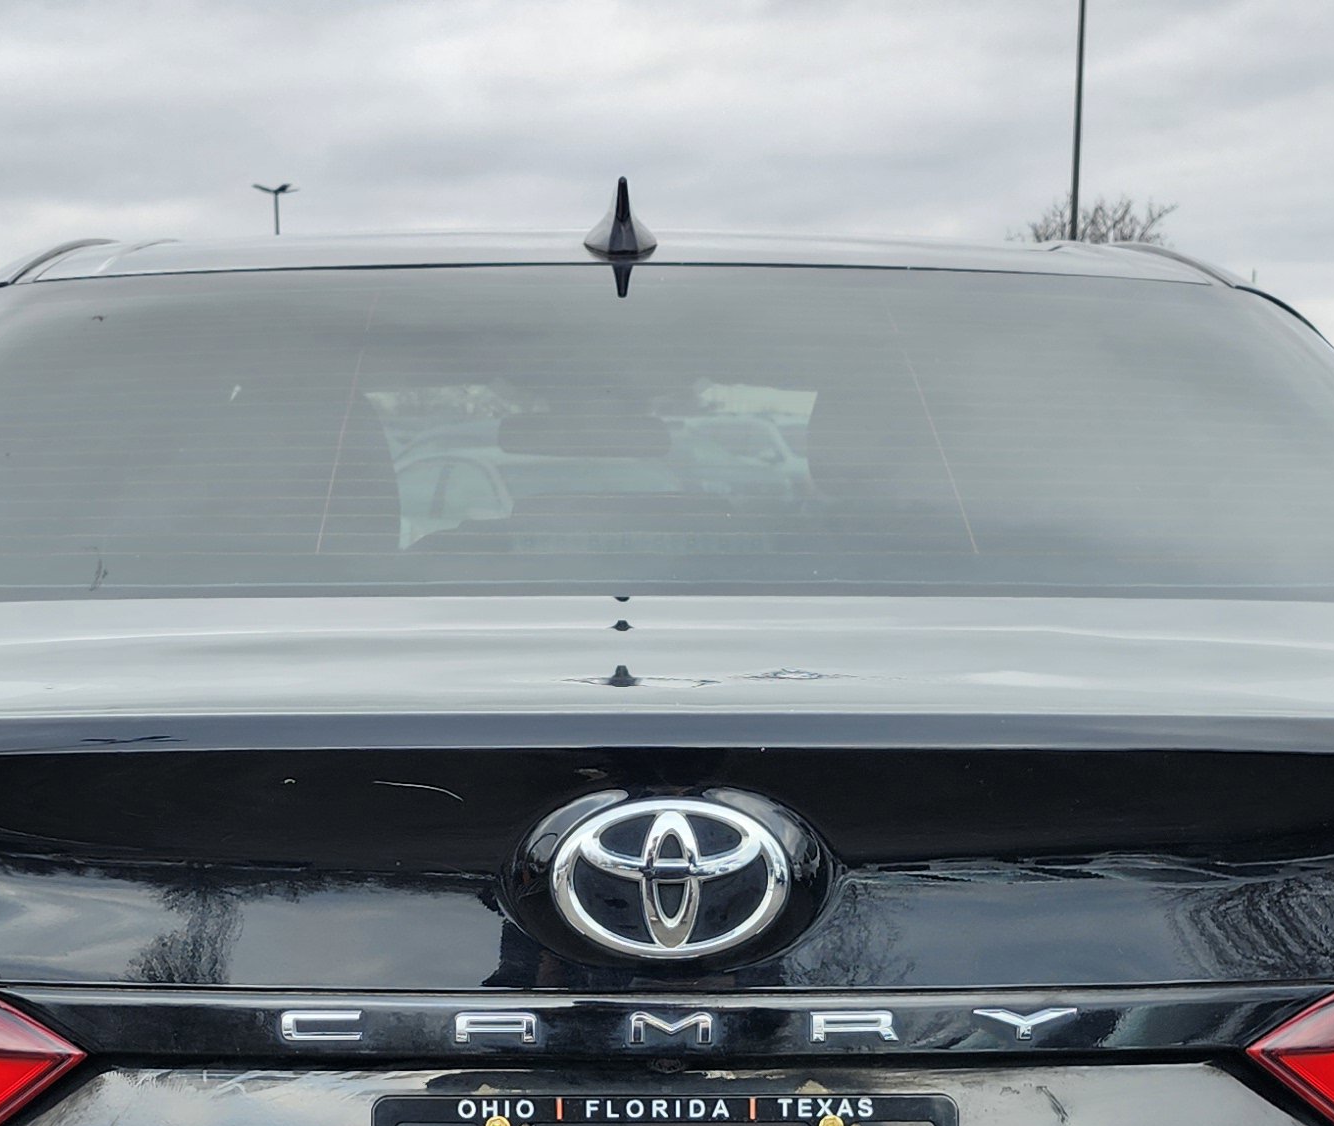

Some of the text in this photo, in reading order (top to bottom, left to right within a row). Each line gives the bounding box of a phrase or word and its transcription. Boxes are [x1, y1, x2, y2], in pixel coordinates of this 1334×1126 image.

[280, 1008, 1078, 1043] CAMRY
[457, 1097, 874, 1119] OHIO FLORIDA TEXAS
